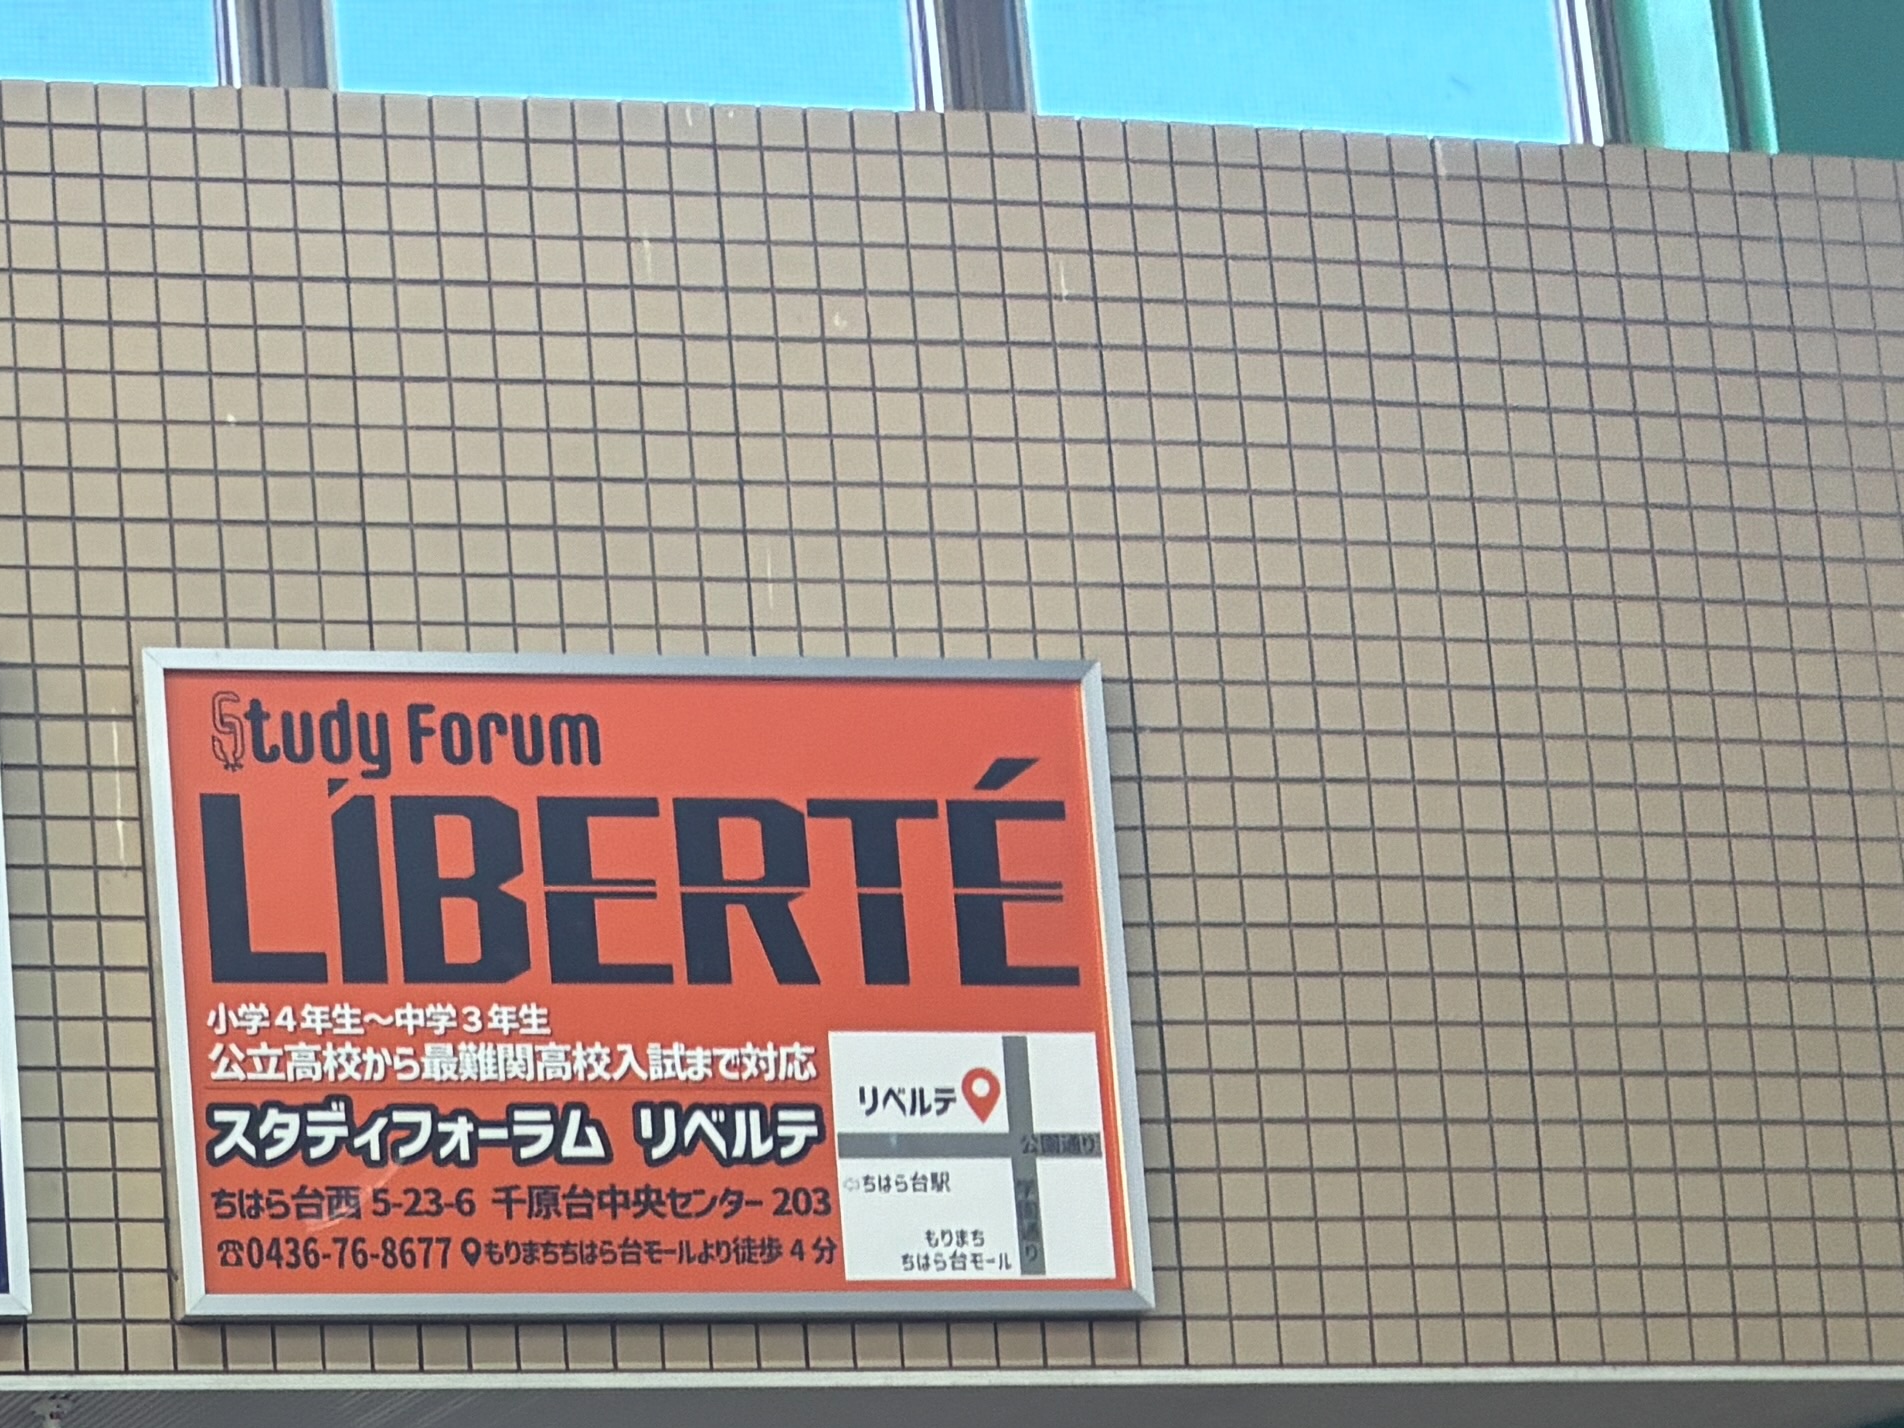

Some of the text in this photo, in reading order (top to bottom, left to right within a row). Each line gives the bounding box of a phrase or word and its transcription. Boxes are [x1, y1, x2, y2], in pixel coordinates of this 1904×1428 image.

[210, 689, 602, 778] Study Forum
[206, 1039, 819, 1083] 公立高校から最難関高校入試まで対応
[857, 1085, 958, 1118] リベルテ
[206, 1097, 824, 1165] スタディフォーラム リベルテ
[861, 1171, 951, 1193] ちはら台駅
[211, 1183, 833, 1221] ちはら台西 5-23-6 千原台中央センター 203
[246, 1235, 453, 1270] 0436-76-8677
[790, 1240, 806, 1262] 4
[812, 1239, 838, 1265] 分
[924, 1229, 985, 1248] もりまち
[900, 1250, 1013, 1273] ちはら台モール
